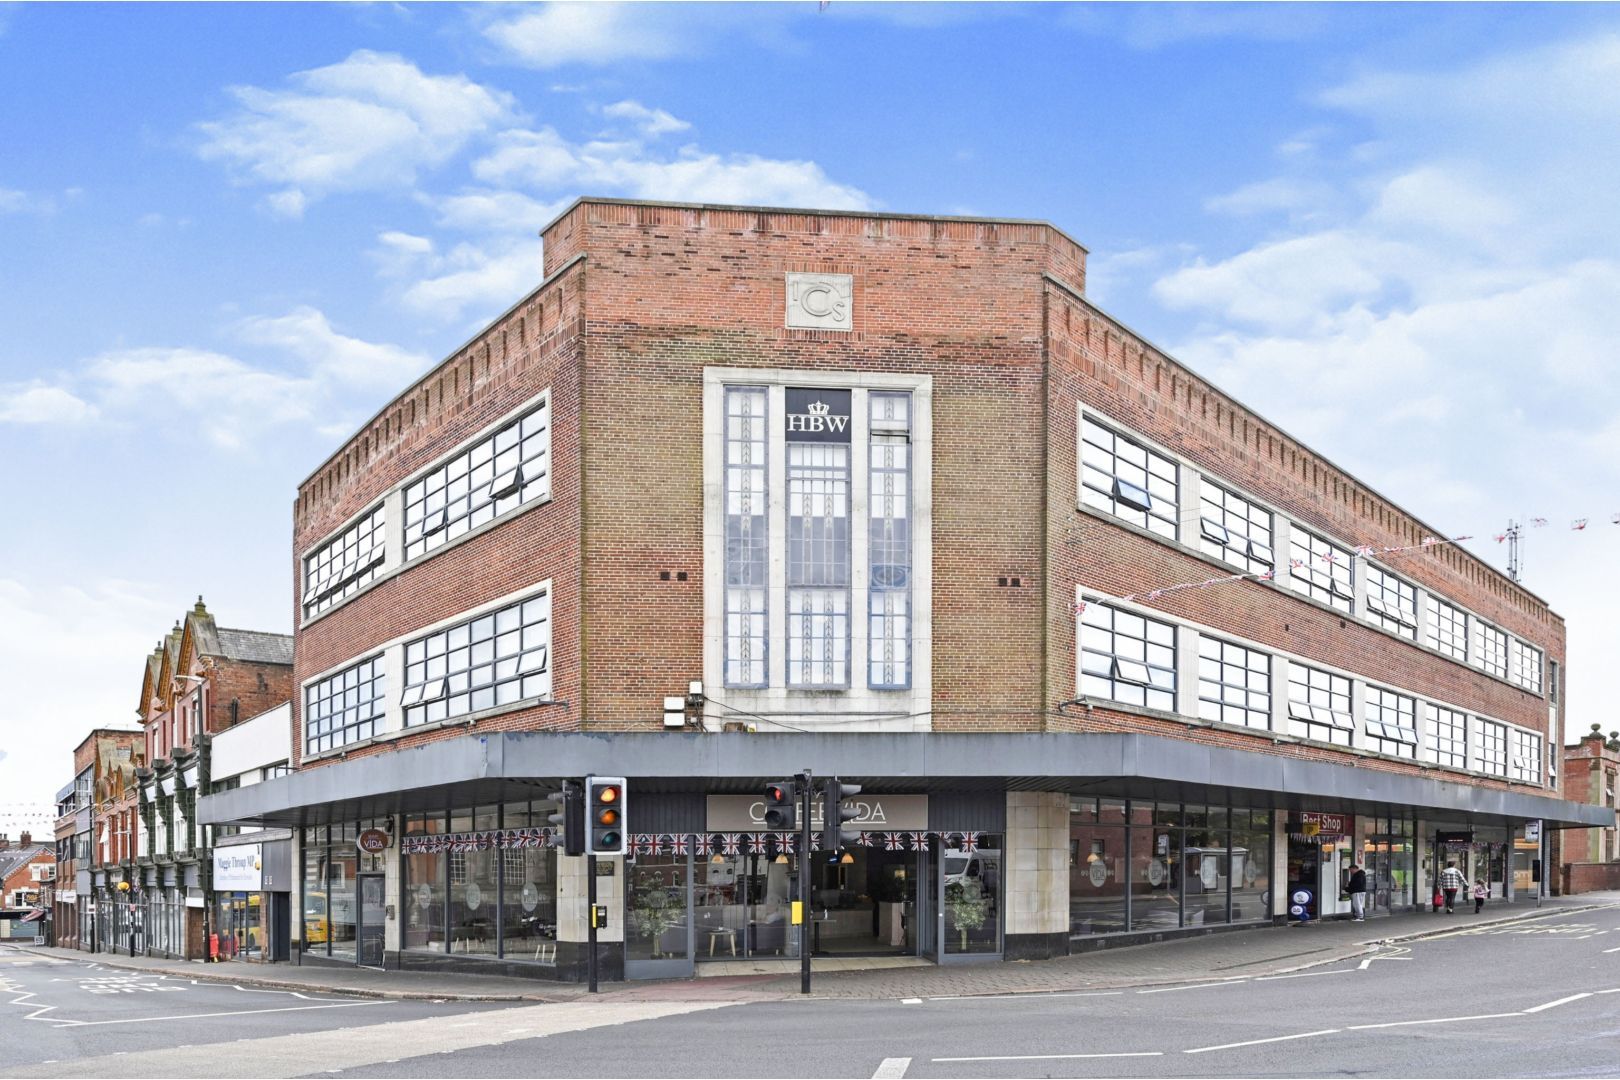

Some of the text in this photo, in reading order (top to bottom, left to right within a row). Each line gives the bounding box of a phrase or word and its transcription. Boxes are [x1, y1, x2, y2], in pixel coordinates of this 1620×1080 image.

[787, 414, 849, 433] HBW
[749, 802, 826, 821] CFEE
[1322, 815, 1341, 832] Shop
[363, 840, 384, 848] VIDA
